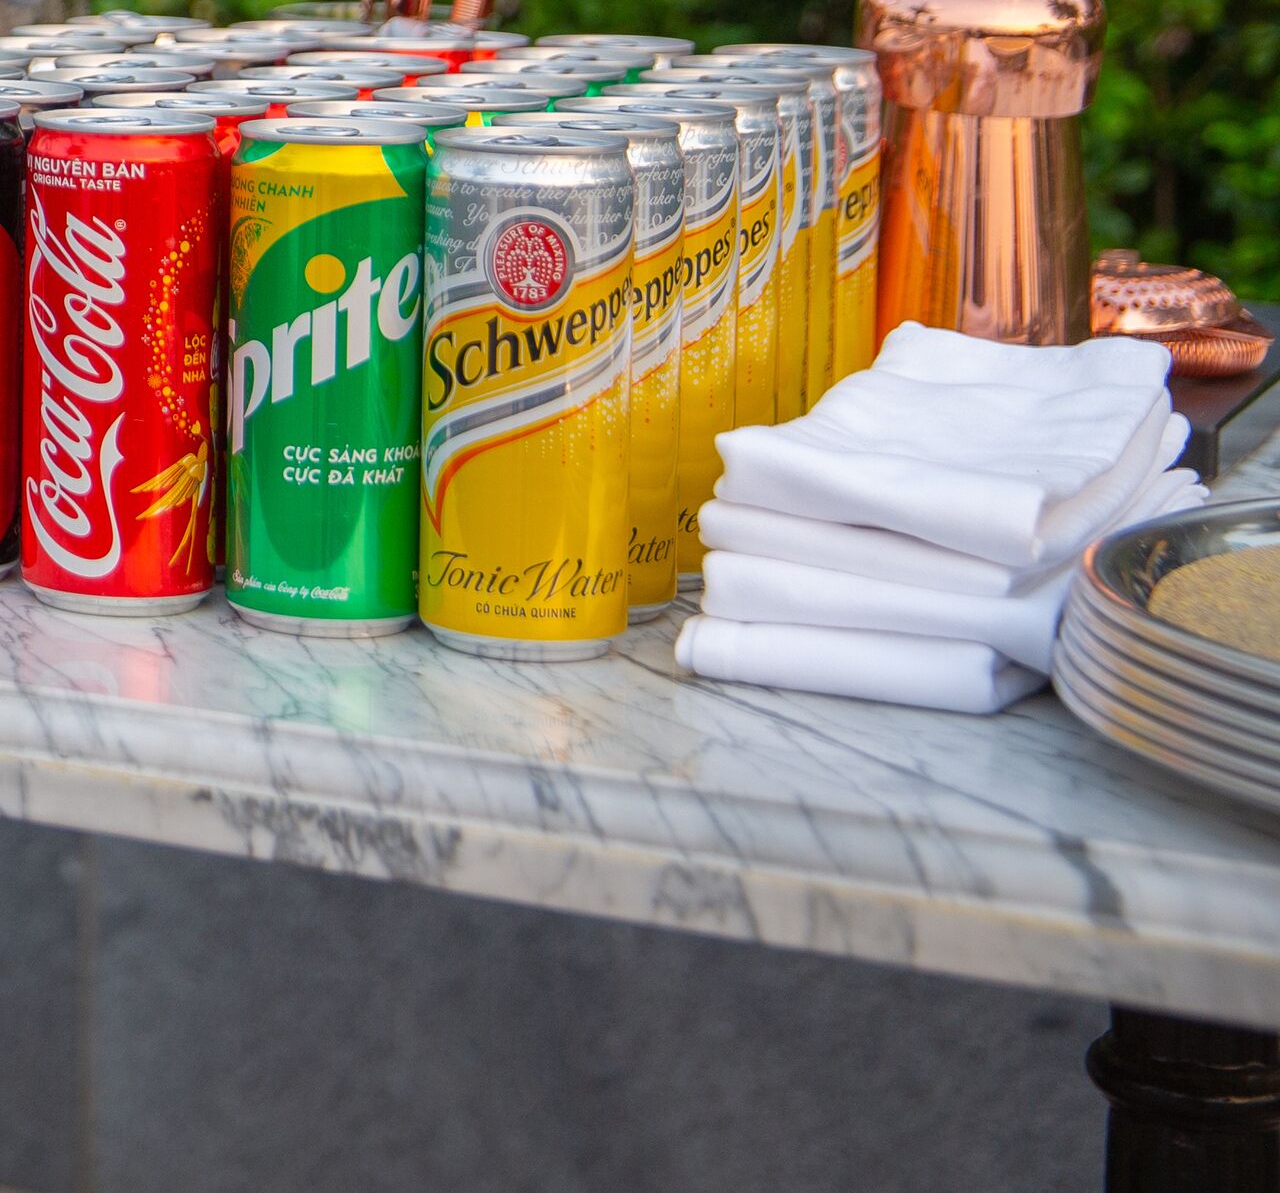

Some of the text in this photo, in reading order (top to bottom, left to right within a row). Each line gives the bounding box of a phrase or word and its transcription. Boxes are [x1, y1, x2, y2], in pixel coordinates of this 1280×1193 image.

[34, 156, 97, 177] NGUYÊN
[101, 159, 146, 179] BẢN
[32, 173, 122, 191] ORIGINAL TASTE
[257, 181, 315, 199] CHANH
[480, 186, 535, 200] create
[536, 185, 566, 200] the
[496, 224, 565, 283] PLEASURE OF MIXING
[511, 285, 548, 300] 1783
[632, 248, 684, 322] eppe
[184, 334, 207, 350] LỘC
[183, 349, 207, 367] ĐẾN
[227, 253, 422, 456] prite
[182, 366, 207, 384] NHÀ
[282, 444, 322, 465] CỰC
[282, 464, 405, 486] CỰC ĐÃ KHÁT
[427, 550, 520, 596] Tonic
[522, 557, 625, 602] Water
[475, 600, 490, 614] CÓ
[530, 606, 577, 619] QUININE
